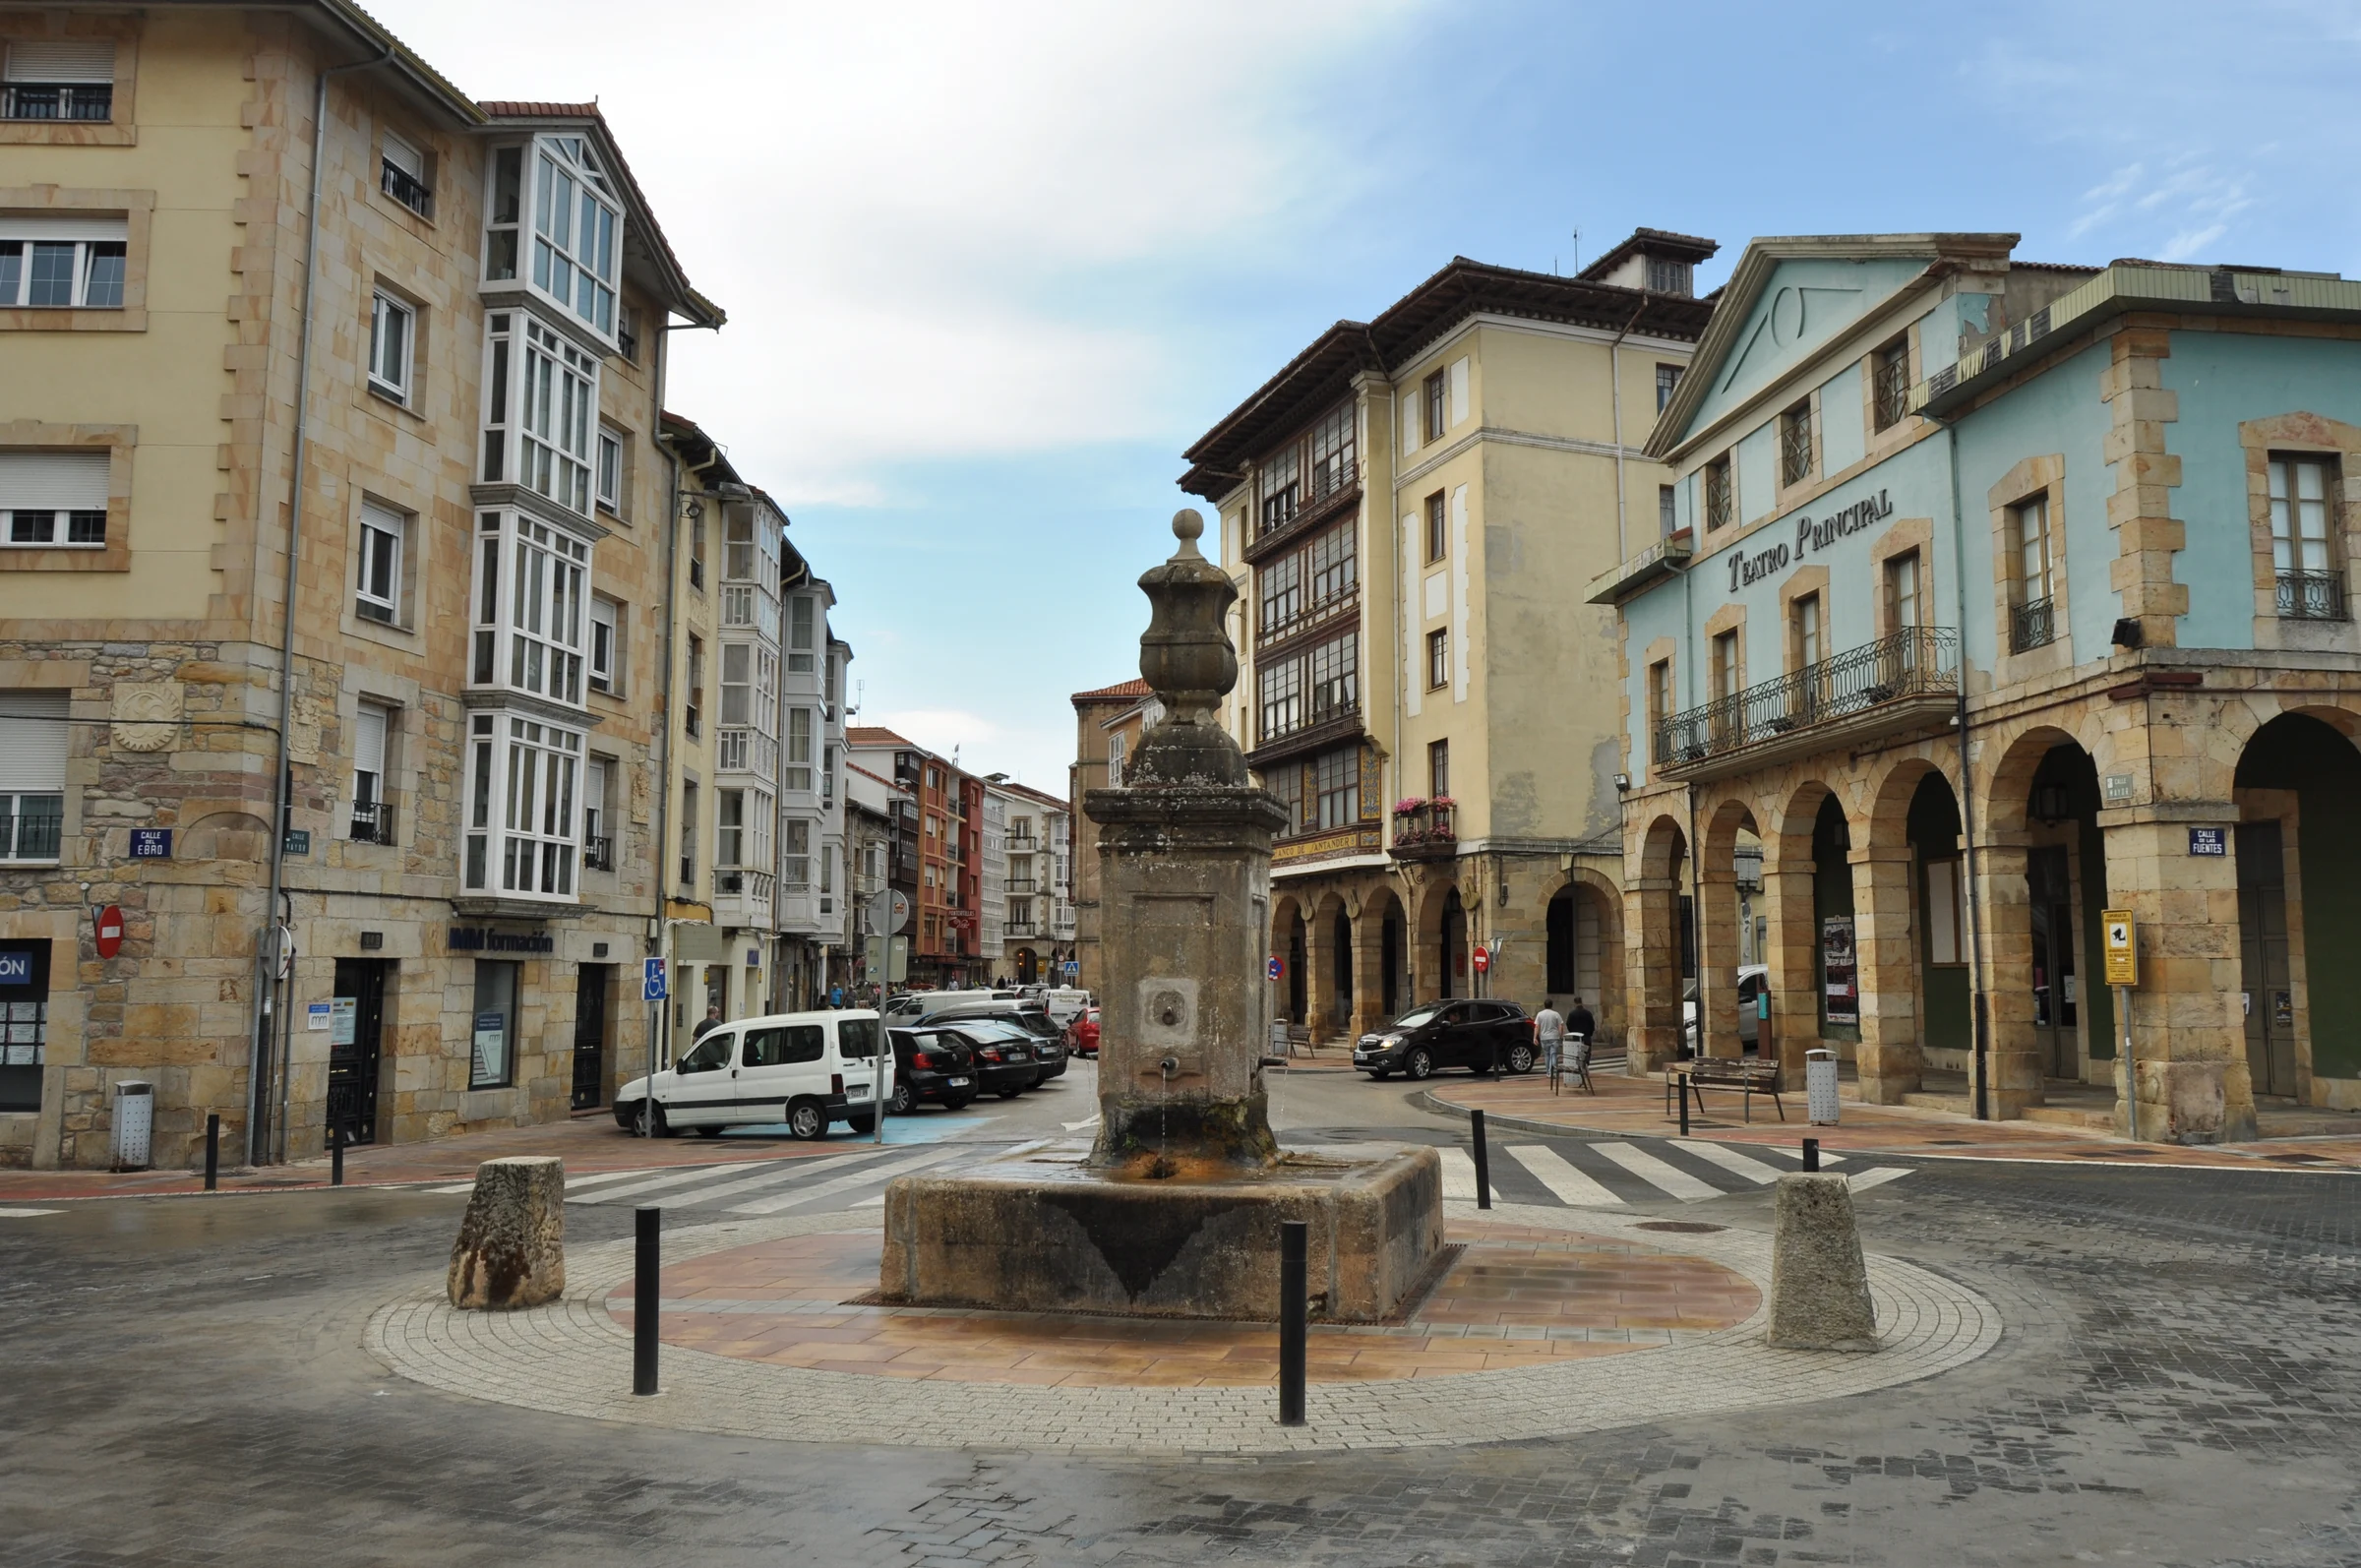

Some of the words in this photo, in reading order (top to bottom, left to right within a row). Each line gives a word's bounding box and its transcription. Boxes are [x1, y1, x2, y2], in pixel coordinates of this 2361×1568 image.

[1727, 542, 1788, 593] TEATRO
[1792, 489, 1893, 561] PRINCIPAL
[138, 844, 163, 855] EBRO
[1298, 845, 1305, 855] DE
[1309, 837, 1350, 853] SANTANDER
[2193, 843, 2222, 854] FUENTES
[486, 927, 553, 953] formación
